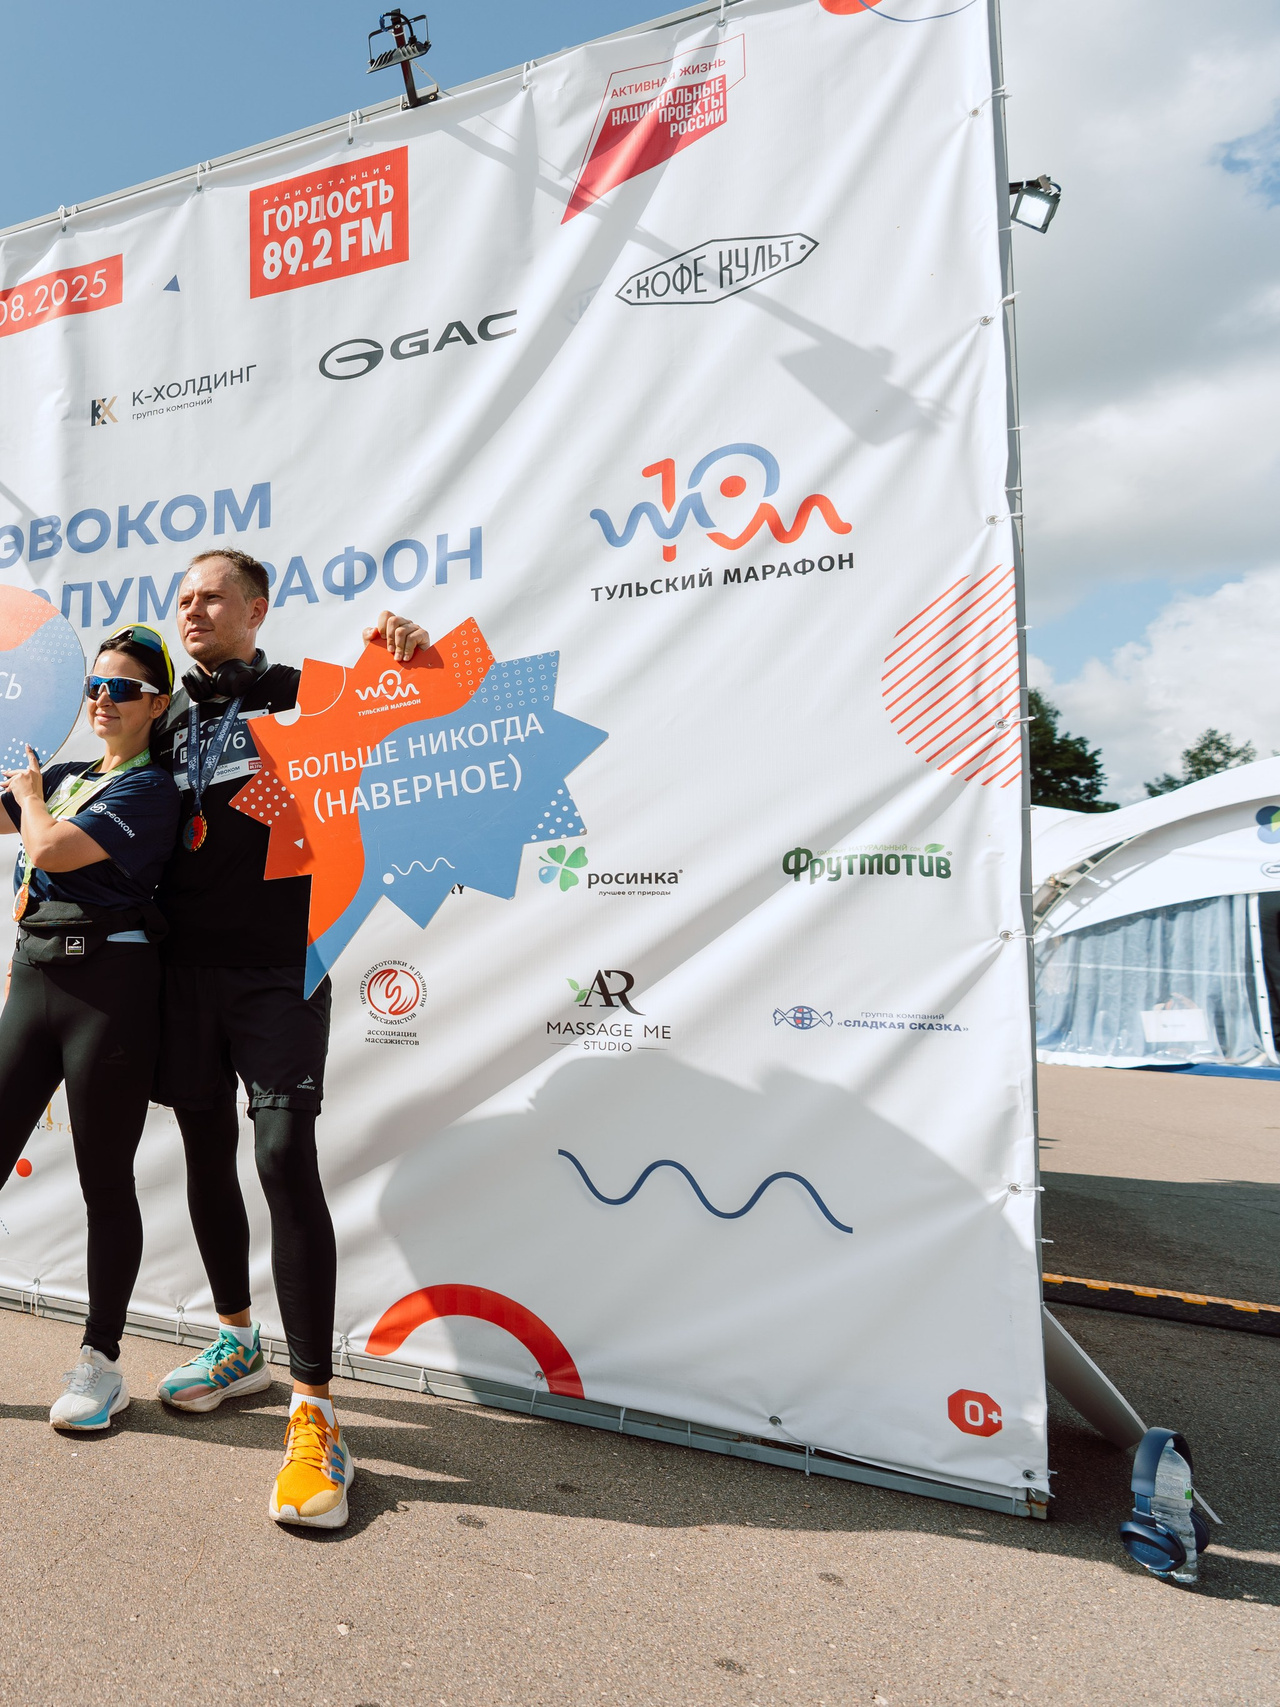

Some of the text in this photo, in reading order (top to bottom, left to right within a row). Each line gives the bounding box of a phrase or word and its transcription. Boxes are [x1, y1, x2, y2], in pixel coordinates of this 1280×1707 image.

[610, 58, 726, 99] АКТИВНАЯ ЖИЗНЬ
[611, 77, 724, 127] НАЦИОНАЛЬНЫЕ
[658, 92, 724, 124] ПРОЕКТЫ
[670, 108, 724, 138] РОССИИ
[263, 164, 391, 205] РАДИОСТАНЦИЯ
[263, 178, 394, 236] ГОРДОСТЬ
[262, 211, 393, 280] 89.2 FM
[636, 240, 794, 299] КОФЕ КУЛЬТ
[390, 309, 517, 360] GAC
[132, 364, 257, 407] К-ХОЛДИНГ
[132, 397, 213, 421] группа компаний
[590, 552, 854, 602] ТУЛЬСКИЙ МАРАФОН
[358, 698, 421, 717] ТУЛЬСКИЙ МАРАФОН
[288, 712, 545, 782] БОЛЬШЕ НИКОГДА
[313, 753, 522, 824] (НАВЕРНОЕ)
[587, 870, 679, 889] росинка
[367, 1029, 418, 1038] ассоциация
[546, 1021, 671, 1040] MASSAGE ME
[860, 1011, 945, 1020] группа компаний
[364, 1037, 420, 1046] массажистов
[583, 1040, 632, 1052] STUDIO
[964, 1400, 1003, 1427] 0+
